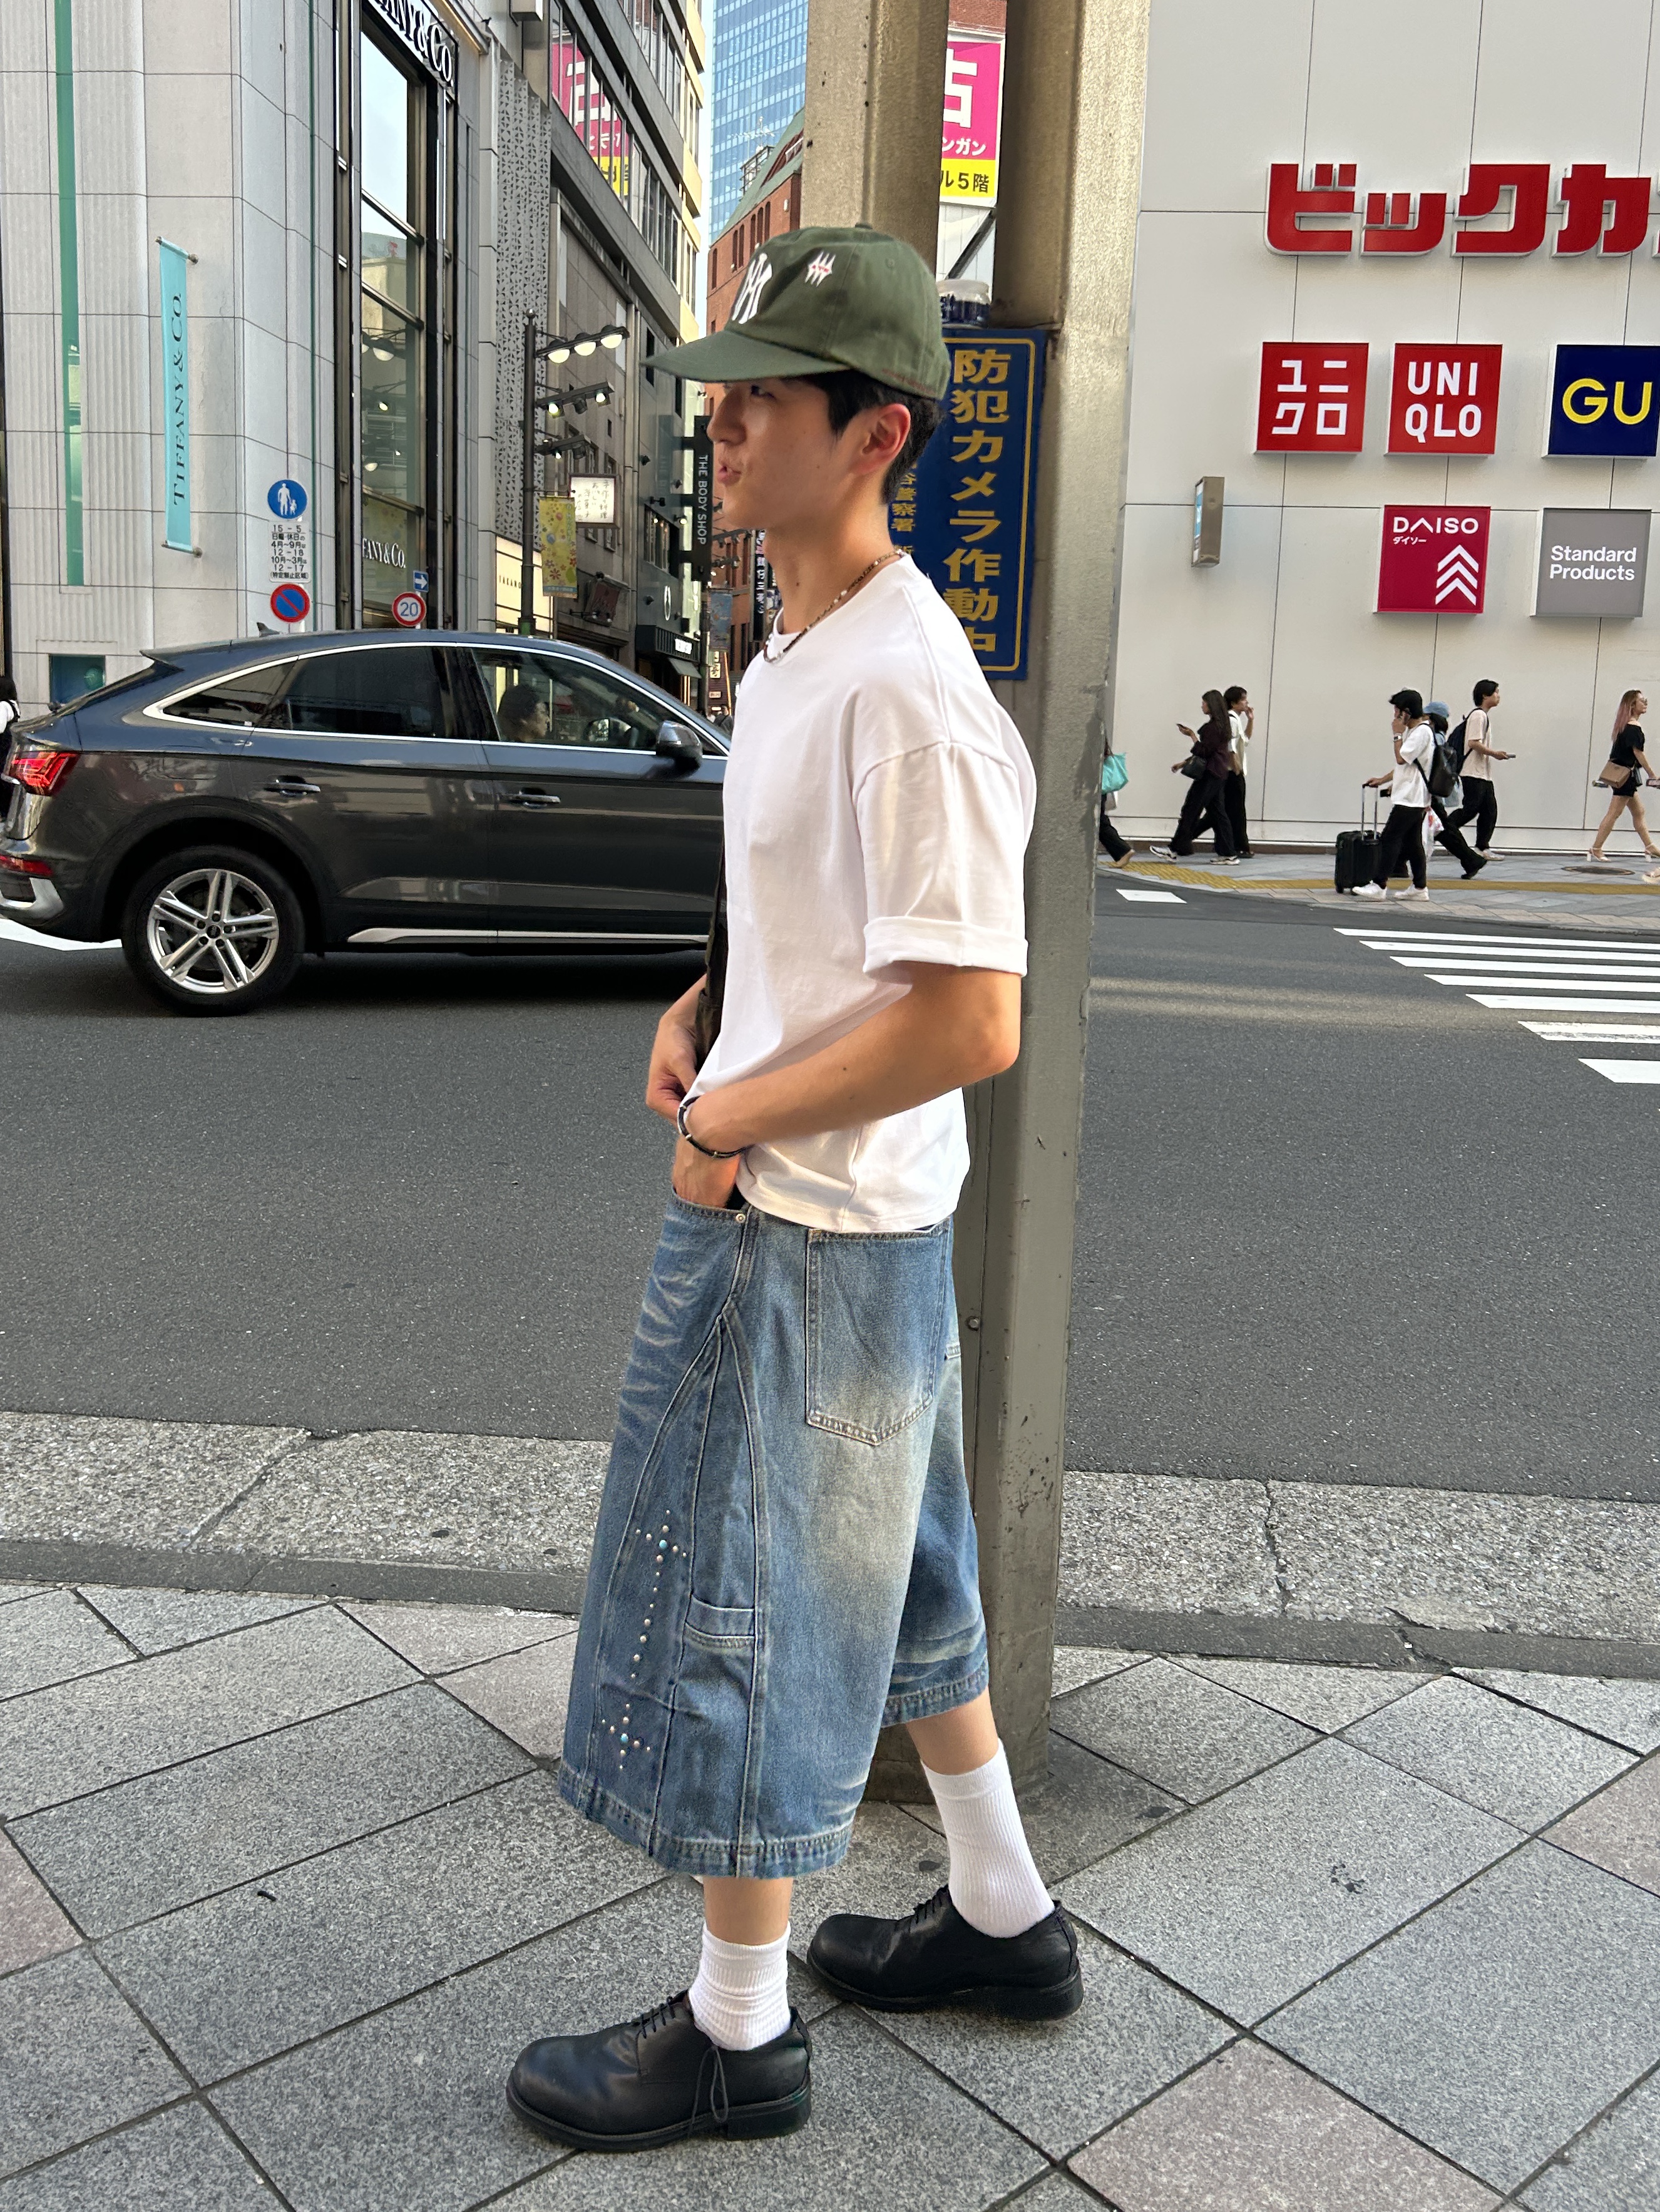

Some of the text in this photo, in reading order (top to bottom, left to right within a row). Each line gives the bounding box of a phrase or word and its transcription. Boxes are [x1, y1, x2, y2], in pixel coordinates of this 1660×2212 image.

[1266, 163, 1660, 254] ビックカ
[1408, 361, 1478, 396] UNI
[1562, 377, 1652, 425] GU
[1405, 403, 1482, 443] QLO
[173, 376, 185, 506] TIFFANY
[697, 454, 709, 545] THE BODY SHOP
[1392, 536, 1428, 545] ダイソー
[1393, 516, 1479, 535] DAISO
[1550, 545, 1637, 562] Standard
[1549, 564, 1636, 580] Products
[400, 602, 418, 617] 20
